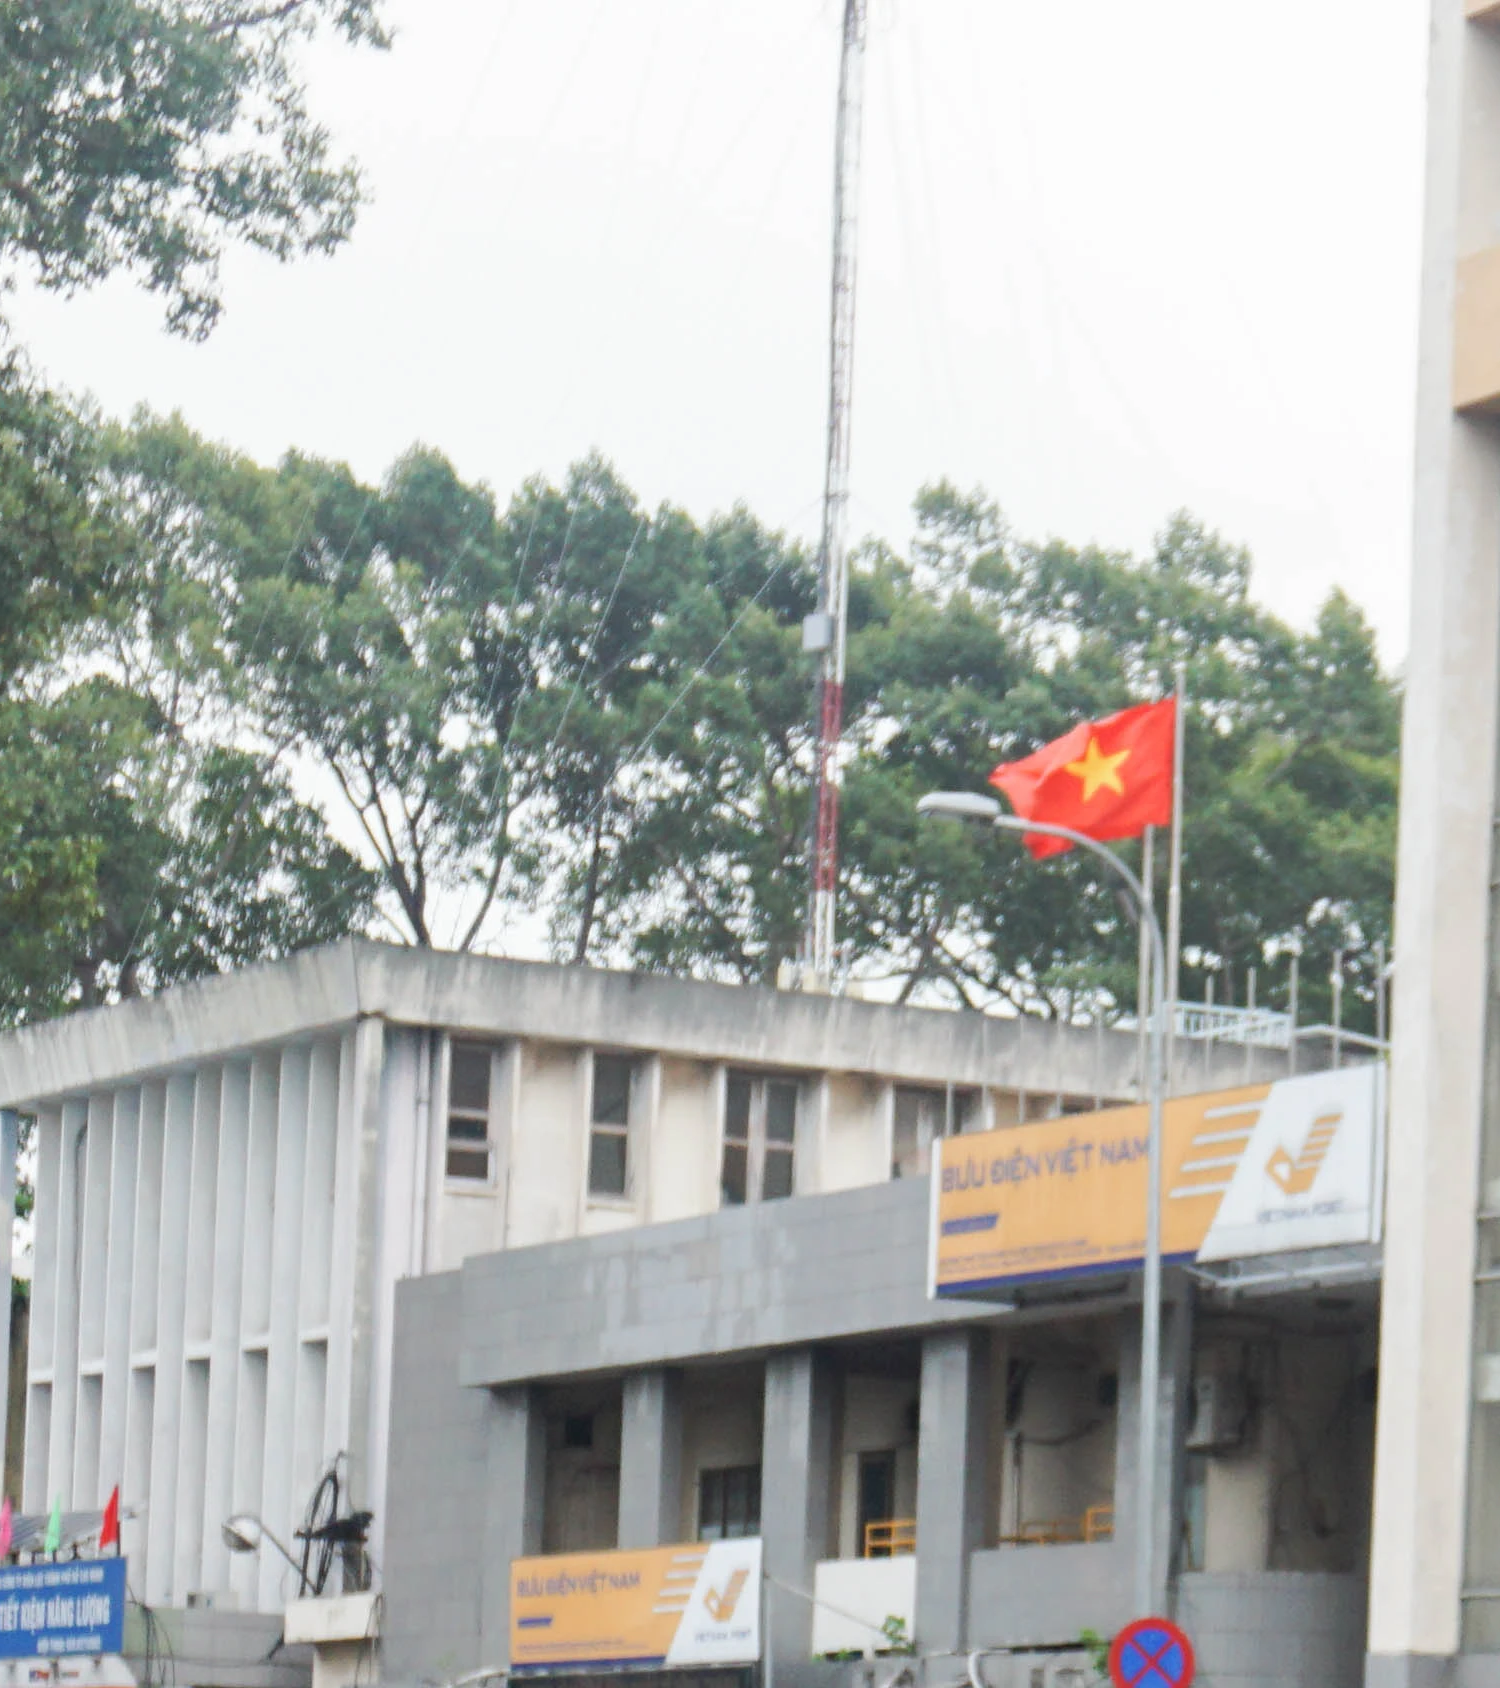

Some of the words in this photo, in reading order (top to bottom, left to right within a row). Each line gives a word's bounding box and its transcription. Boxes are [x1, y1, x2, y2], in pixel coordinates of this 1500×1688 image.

[941, 1154, 986, 1193] BƯU
[990, 1145, 1041, 1190] ĐIỆN
[1044, 1137, 1094, 1181] VIỆT
[608, 1569, 641, 1590] NAM
